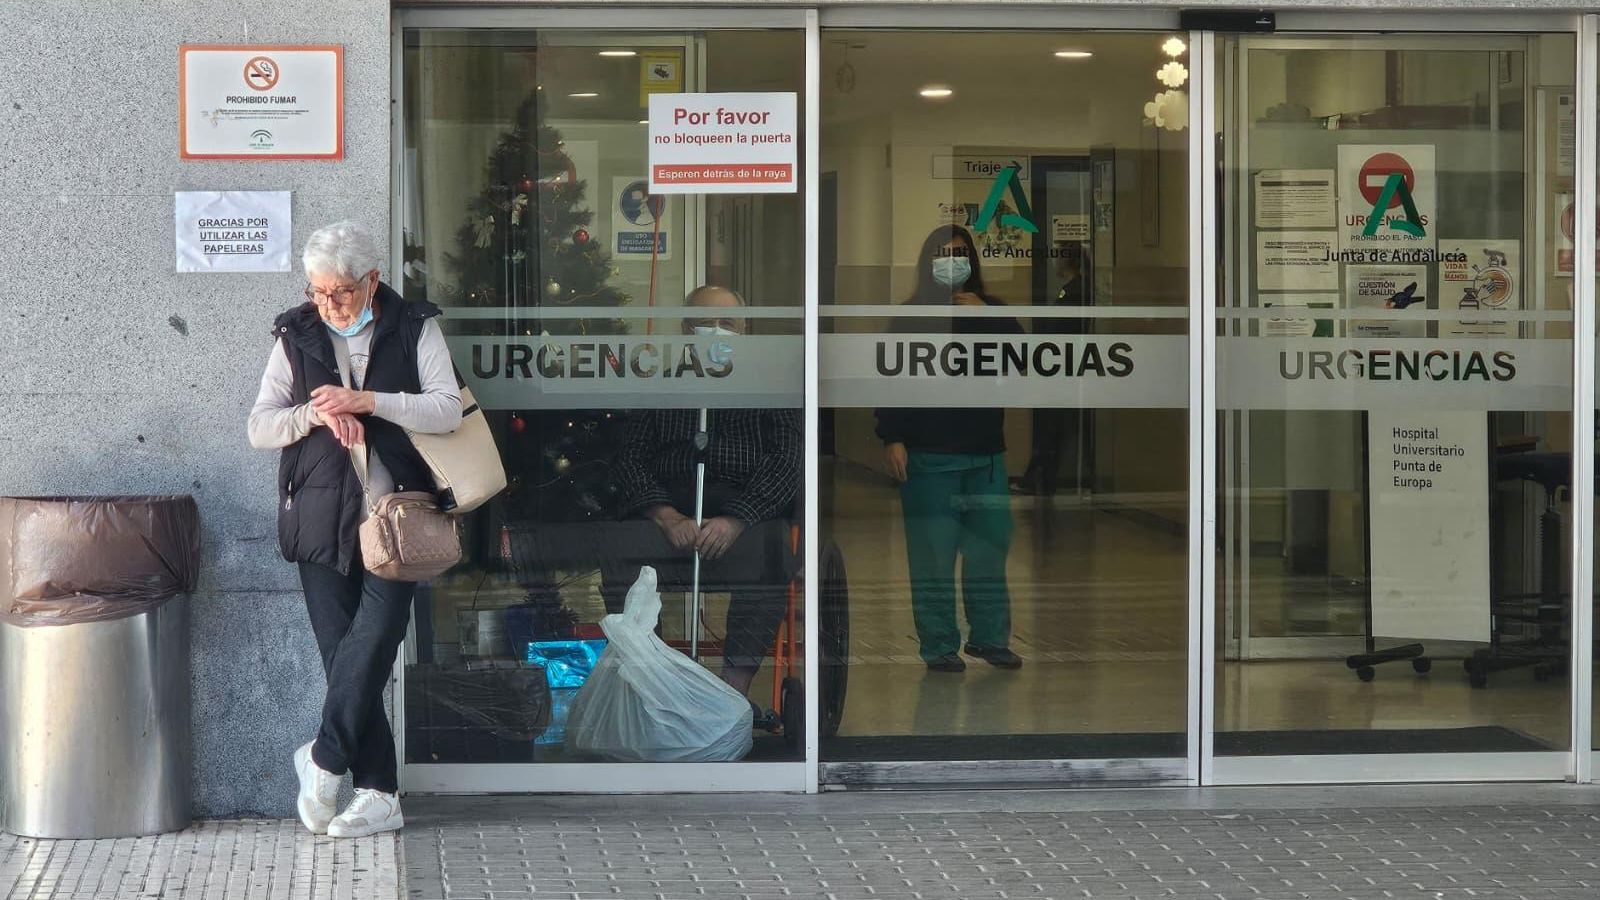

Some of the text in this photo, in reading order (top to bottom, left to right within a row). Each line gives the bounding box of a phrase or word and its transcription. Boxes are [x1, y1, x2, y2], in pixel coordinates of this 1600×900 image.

[226, 96, 297, 104] PROHIBIDO FUMAR
[674, 108, 770, 125] Por favor
[655, 132, 792, 146] no bloqueen la puerta
[658, 169, 700, 180] Esperen
[737, 168, 750, 178] de
[752, 168, 761, 178] la
[764, 170, 786, 180] raya
[964, 160, 1001, 175] Triaje
[198, 218, 268, 227] GRACIAS POR
[200, 231, 268, 240] UTILIZAR LAS
[204, 244, 264, 253] PAPELERAS
[982, 244, 1000, 259] de
[1323, 248, 1365, 263] Junta
[1369, 248, 1388, 263] de
[1391, 247, 1467, 263] Andalucía
[472, 342, 734, 379] URGENCIAS
[876, 341, 1134, 377] URGENCIAS
[1279, 349, 1516, 382] URGENCIAS
[1393, 427, 1438, 441] Hospital
[1393, 443, 1465, 456] Universitario
[1393, 460, 1442, 472] Punta de
[1393, 476, 1432, 490] Europa
